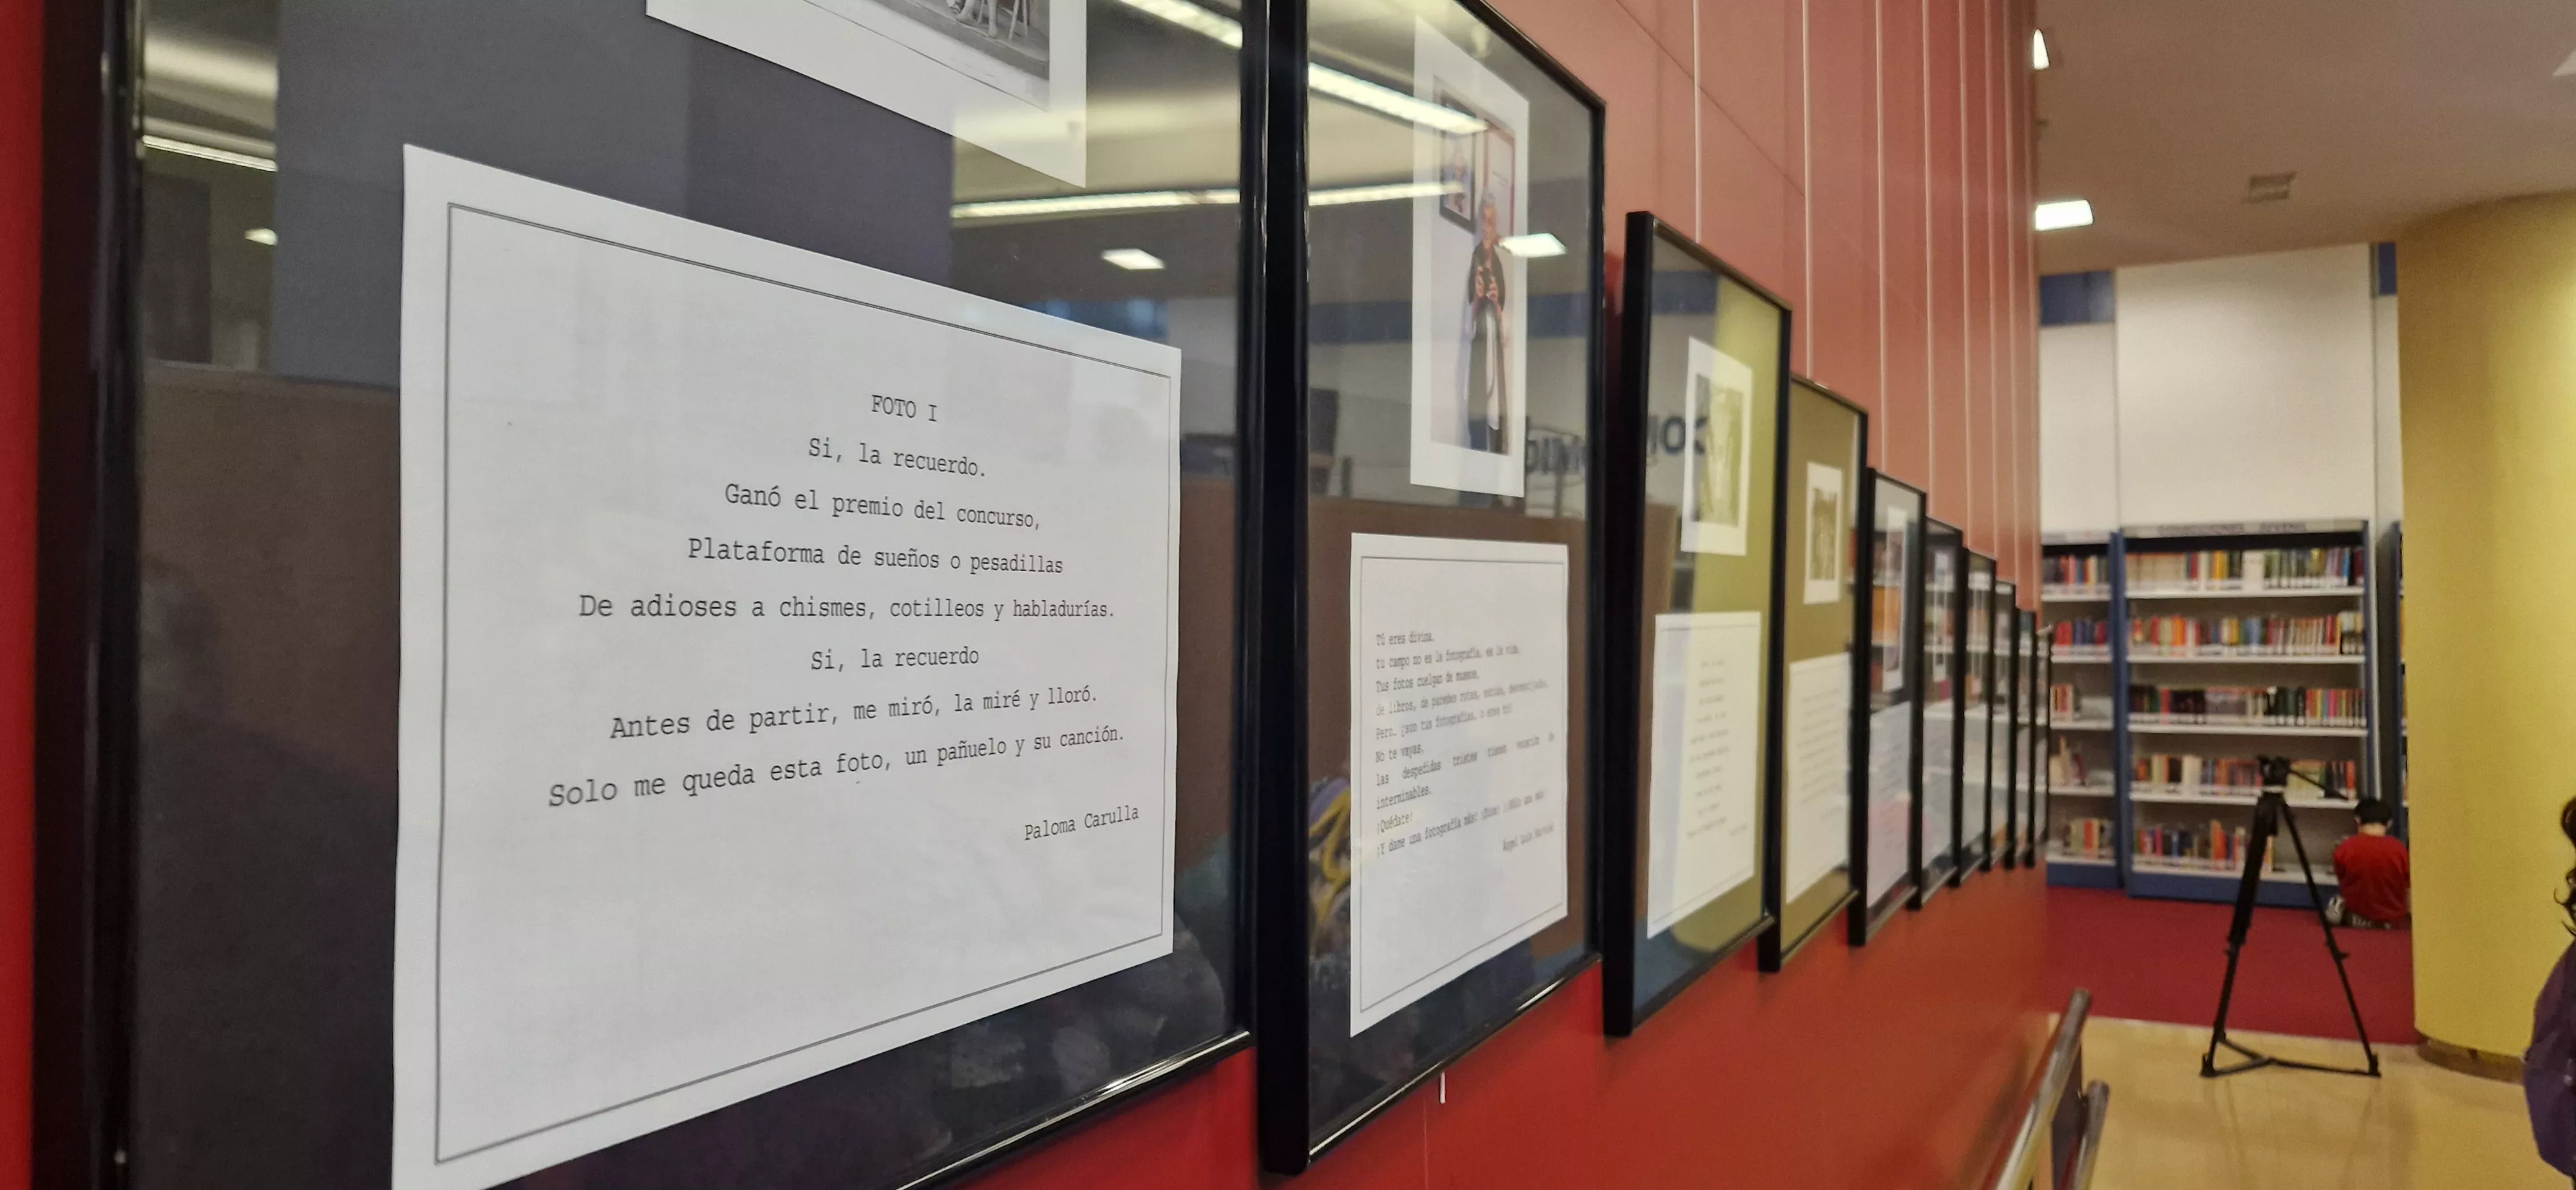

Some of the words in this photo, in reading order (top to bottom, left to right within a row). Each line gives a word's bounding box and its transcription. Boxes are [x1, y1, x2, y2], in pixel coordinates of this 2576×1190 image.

[871, 394, 917, 419] FOTO
[927, 404, 938, 422] I
[808, 437, 842, 463] Si,
[858, 442, 882, 465] la
[893, 451, 985, 477] recuerdo.
[724, 483, 782, 507] Ganó
[794, 489, 820, 511] el
[831, 495, 904, 518] premio
[913, 499, 946, 520] del
[956, 507, 1039, 531] concurso,
[688, 536, 826, 564] Plataforma
[837, 544, 862, 565] de
[874, 547, 940, 569] sueños
[950, 555, 961, 569] o
[969, 553, 1063, 575] pesadillas
[578, 594, 614, 618] De
[630, 592, 737, 618] adioses
[751, 600, 766, 617] a
[779, 595, 875, 620] chismes,
[889, 597, 985, 618] cotilleos
[993, 603, 1005, 622] y
[1012, 599, 1114, 618] habladurías.
[1388, 634, 1406, 645] eres
[811, 648, 844, 673] Si,
[860, 648, 884, 668] la
[895, 645, 980, 667] recuerdo
[1376, 658, 1385, 670] tu
[1388, 656, 1410, 670] campo
[1412, 655, 1422, 666] no
[1424, 654, 1433, 664] es
[1376, 680, 1389, 693] Tus
[1393, 677, 1414, 691] fotos
[609, 715, 691, 740] Antes
[706, 708, 735, 732] de
[748, 702, 838, 735] partir,
[852, 704, 878, 720] me
[887, 694, 940, 717] miró,
[954, 693, 974, 712] la
[982, 688, 1021, 710] miré
[1029, 693, 1040, 711] y
[1048, 684, 1097, 705] lloró.
[548, 778, 618, 808] Solo
[633, 777, 666, 797] me
[682, 763, 756, 798] queda
[770, 759, 823, 782] esta
[836, 752, 891, 773] foto,
[904, 749, 928, 766] un
[936, 737, 1007, 767] pañuelo
[1014, 739, 1026, 757] y
[1033, 735, 1052, 750] su
[1059, 724, 1124, 747] canción.
[1375, 750, 1385, 763] No
[1388, 749, 1397, 760] te
[1376, 773, 1390, 786] las
[1402, 759, 1442, 780] despedidas
[1024, 818, 1077, 841] Paloma
[1084, 804, 1139, 829] Carulla
[1388, 838, 1406, 852] dame
[1408, 832, 1422, 845] una
